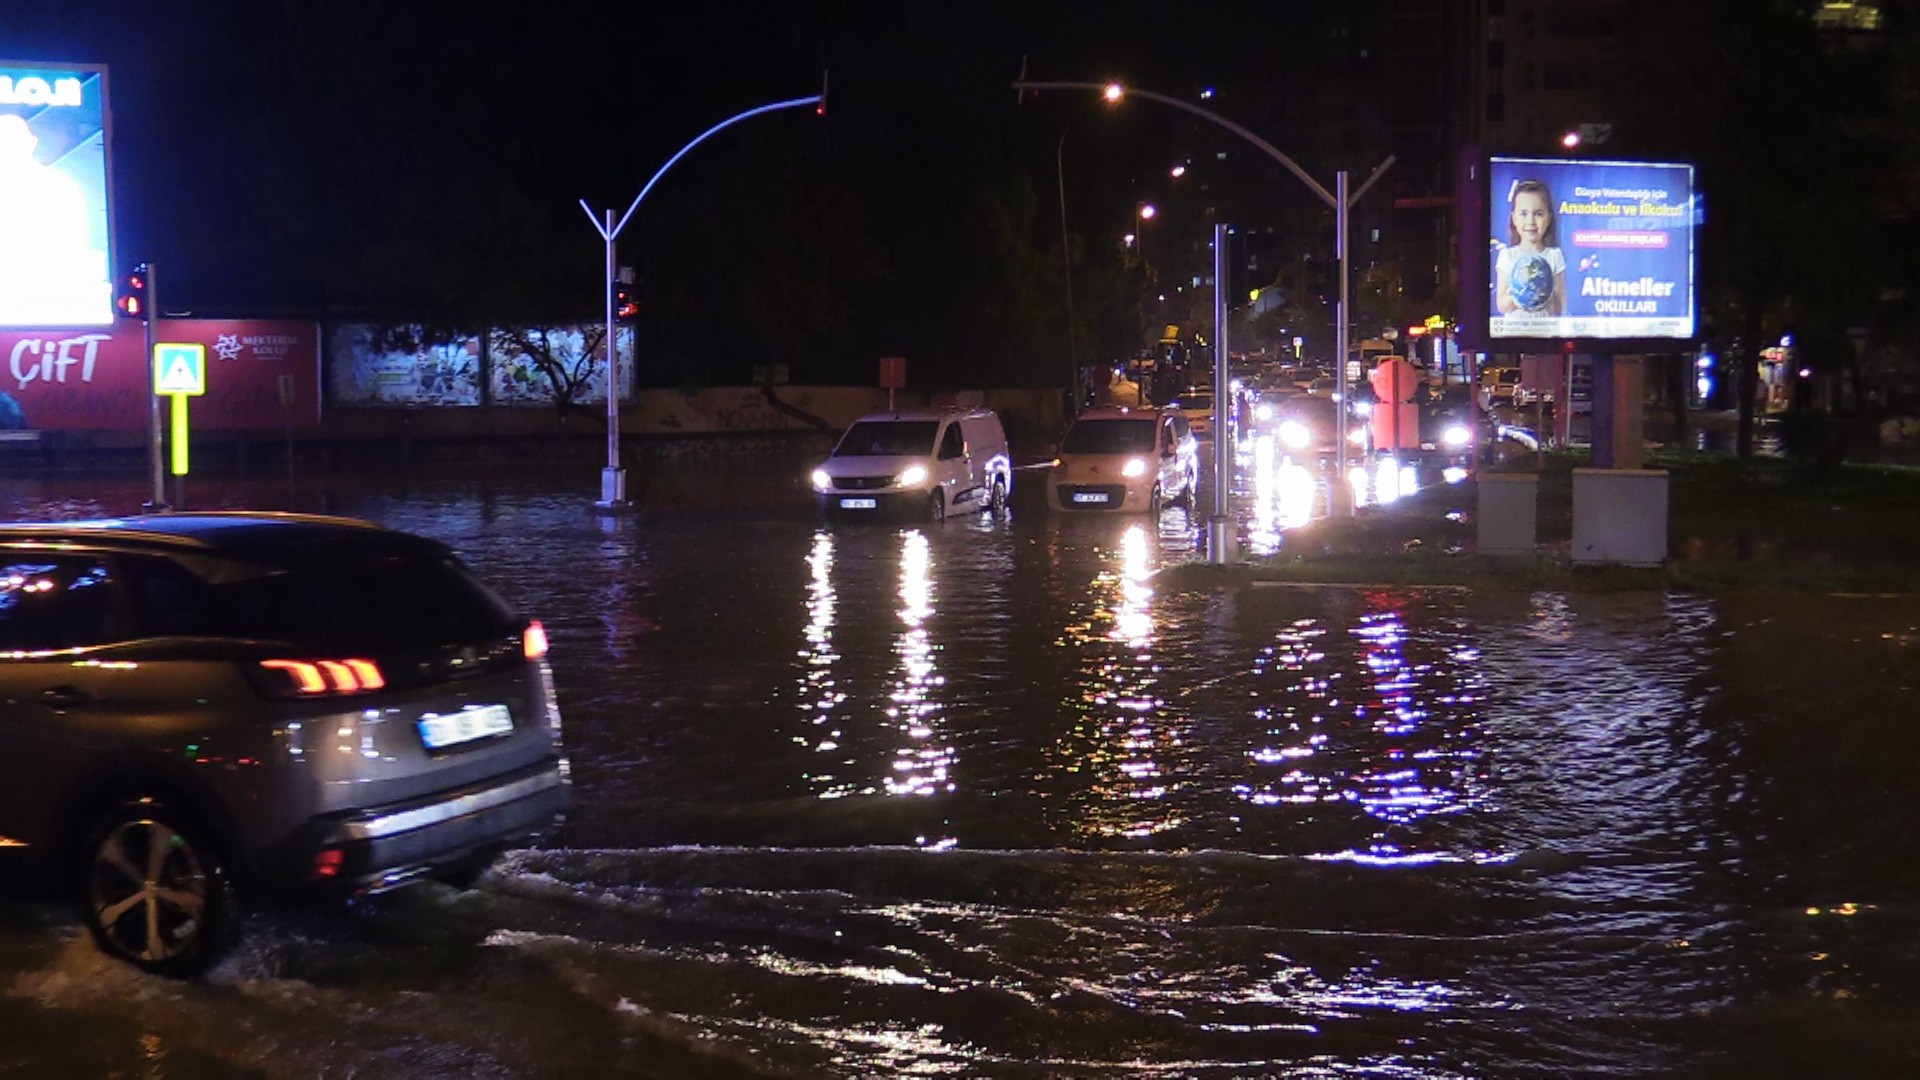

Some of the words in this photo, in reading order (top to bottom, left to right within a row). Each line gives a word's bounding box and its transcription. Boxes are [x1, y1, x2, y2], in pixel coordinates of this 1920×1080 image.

[1559, 201, 1620, 215] Anaokulu
[1622, 205, 1637, 215] ve
[1581, 277, 1675, 296] Altıneller
[1594, 300, 1657, 313] OKULLARI
